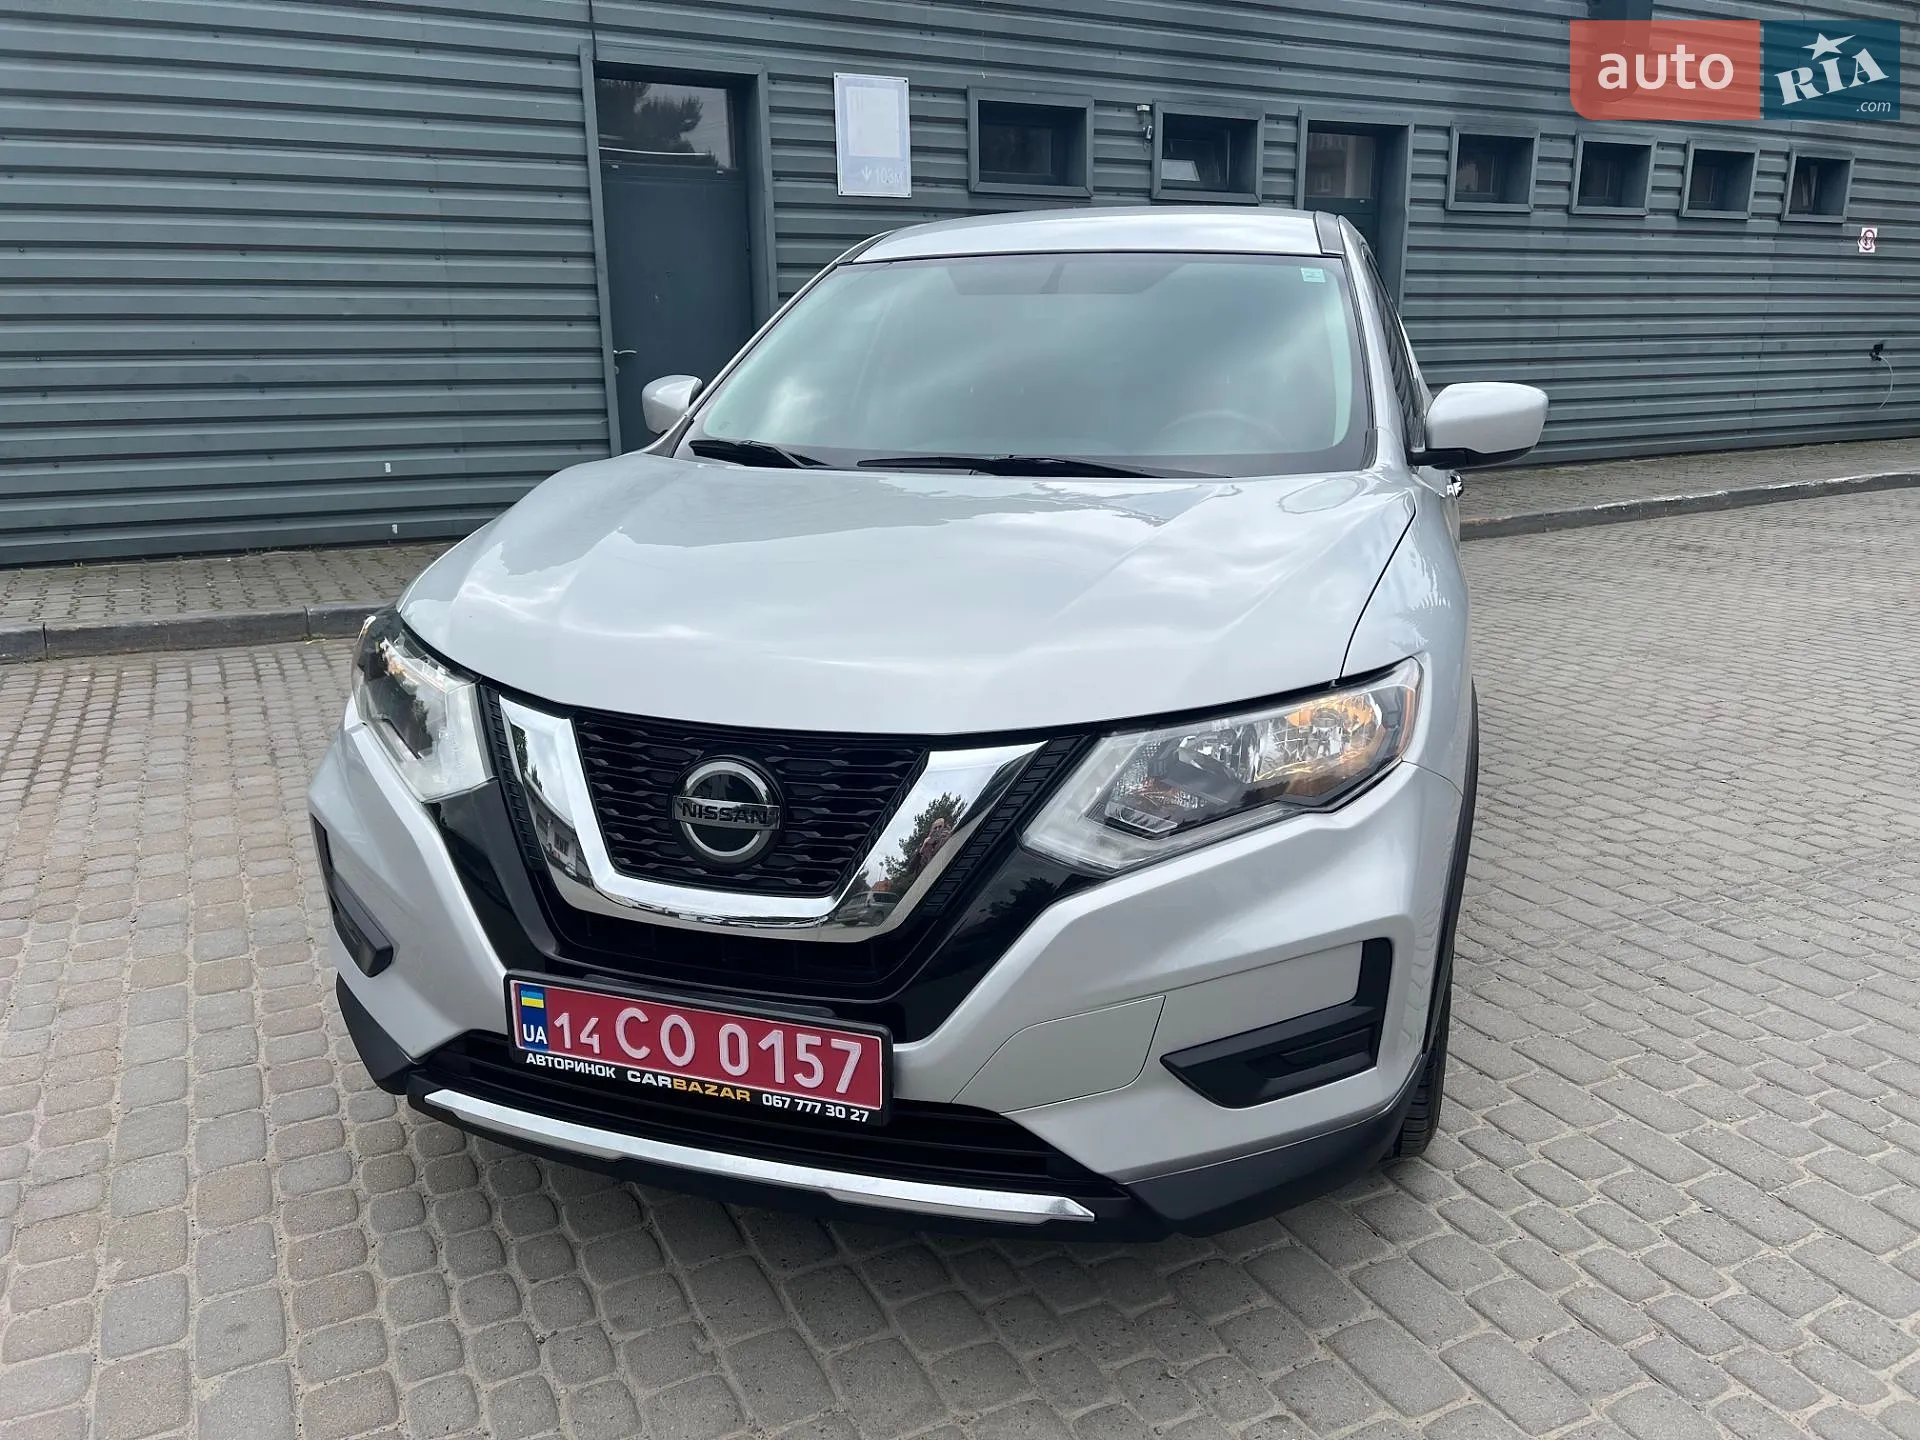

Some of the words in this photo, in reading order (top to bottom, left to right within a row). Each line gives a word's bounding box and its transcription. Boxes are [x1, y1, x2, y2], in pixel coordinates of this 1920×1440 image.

[682, 802, 768, 824] NISSAN
[522, 1023, 548, 1045] UA
[553, 1012, 600, 1054] 14
[615, 1007, 696, 1067] CO
[719, 1023, 862, 1094] 0157
[526, 1053, 616, 1079] АВТОРИНОК
[627, 1070, 751, 1103] CARBAZAR
[762, 1093, 792, 1109] 067
[794, 1099, 822, 1114] 777
[825, 1104, 846, 1119] 30
[850, 1109, 870, 1123] 27
